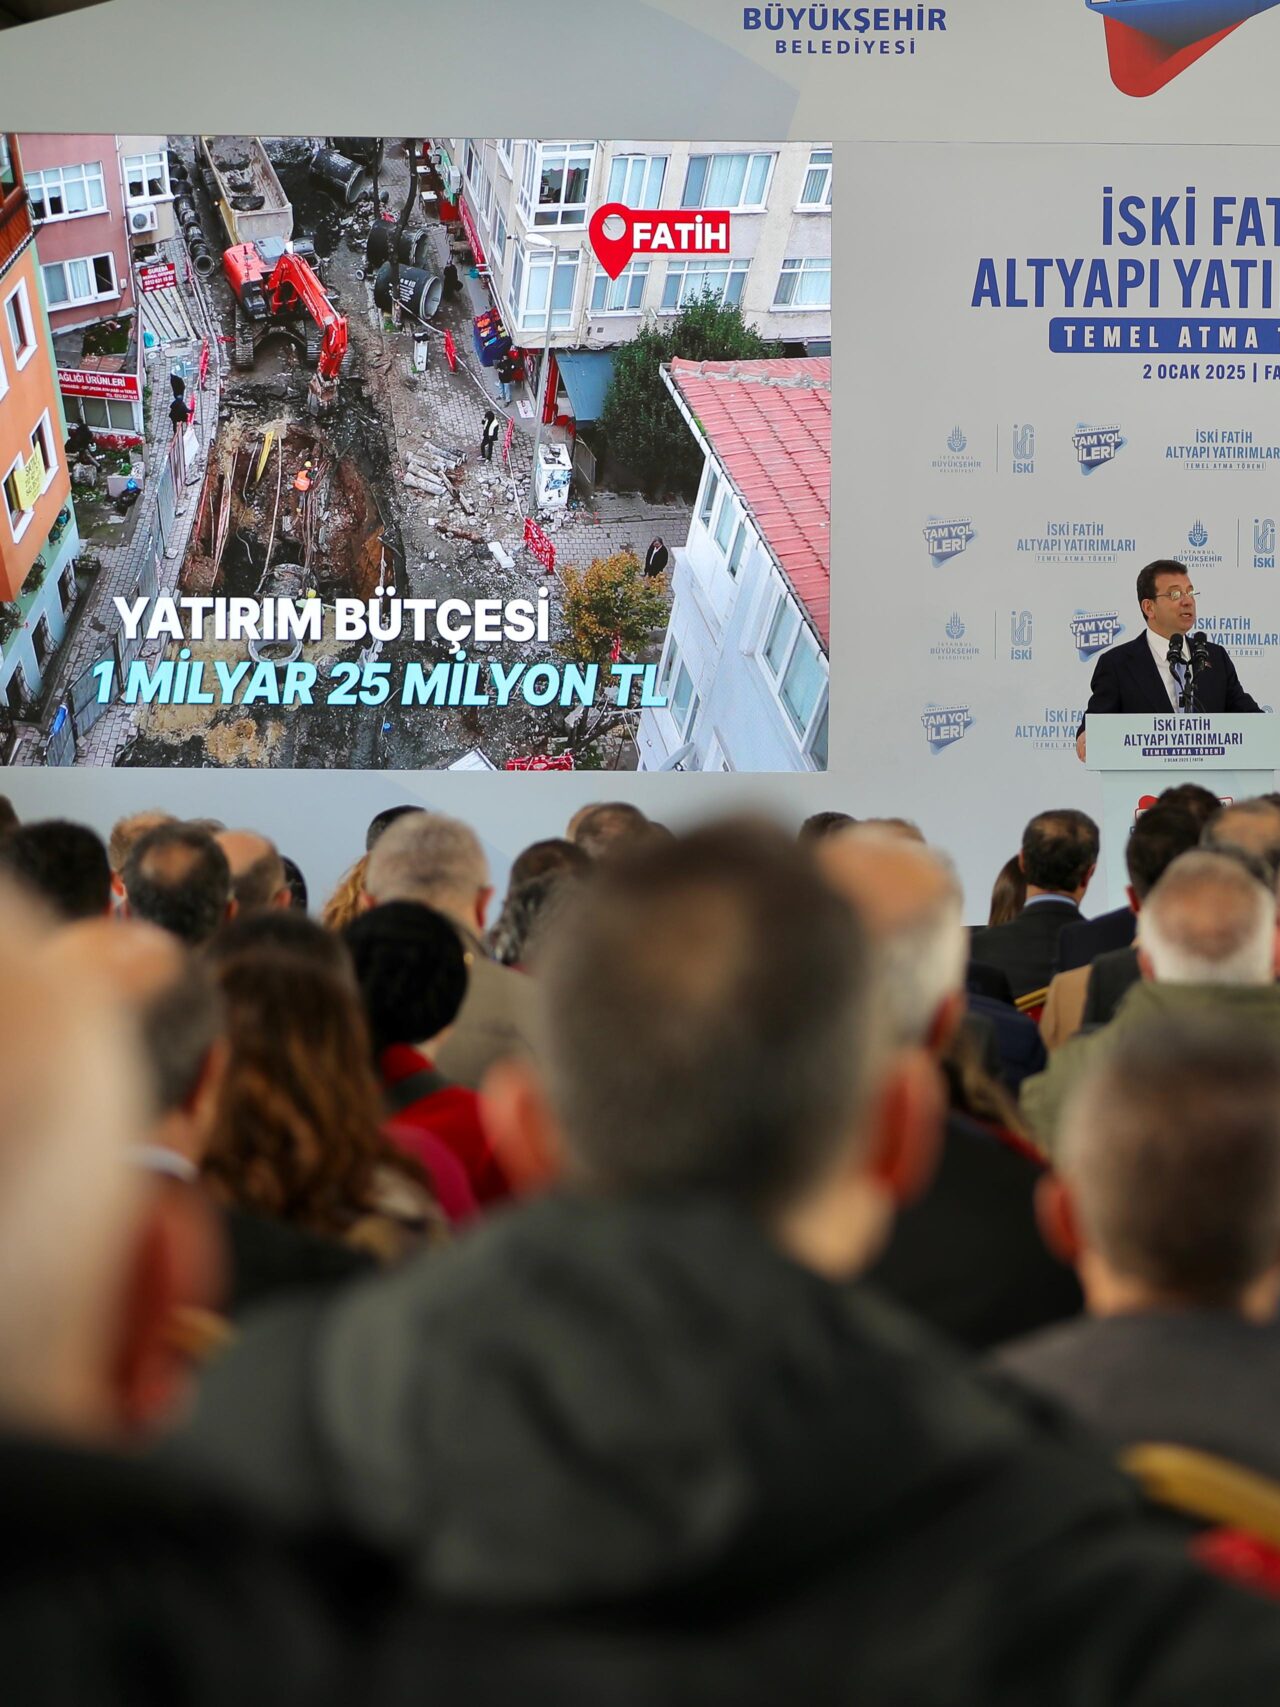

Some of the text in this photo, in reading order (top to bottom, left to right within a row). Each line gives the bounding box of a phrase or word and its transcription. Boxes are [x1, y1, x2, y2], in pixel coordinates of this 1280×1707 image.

[743, 3, 946, 33] BÜYÜKŞEHİR
[775, 38, 915, 54] BELEDİYESİ
[1103, 186, 1196, 246] İSKİ
[633, 215, 726, 249] FATİH
[971, 258, 1160, 308] ALTYAPI
[1064, 325, 1159, 348] TEMEL
[1178, 326, 1259, 349] ATMA
[1143, 364, 1152, 380] 2
[1158, 364, 1200, 380] OCAK
[1206, 364, 1247, 381] 2025
[86, 374, 126, 387] ÜRÜNLERİ
[1072, 433, 1121, 446] TAM YOL
[1195, 429, 1253, 443] İSKİ FATİH
[1079, 443, 1115, 461] İLERİ
[1165, 446, 1210, 459] ALTYAPI
[931, 460, 981, 468] BÜYÜKŞEHİR
[1012, 460, 1034, 473] İSKİ
[923, 525, 972, 539] TAM YOL
[1047, 521, 1104, 536] İSKİ FATİH
[930, 535, 966, 553] İLERİ
[1016, 539, 1136, 551] ALTYAPI YATIRIMLARI
[1253, 555, 1275, 568] İSKİ
[113, 586, 549, 654] YATIRIM BÜTÇESİ
[1071, 619, 1119, 632] TAM YOL
[1220, 616, 1251, 630] FATİH
[1076, 629, 1113, 648] İLERİ
[1010, 647, 1032, 660] İSKİ
[93, 648, 668, 707] 1 MİLYAR 25 MİLYON TL
[922, 711, 971, 725] TAM YOL
[1045, 708, 1068, 722] İSKİ
[1153, 716, 1211, 731] İSKİ FATİH
[927, 722, 964, 740] İLERİ
[1015, 725, 1059, 738] ALTYAPI
[1123, 733, 1243, 746] ALTYAPI YATIRIMLARI
